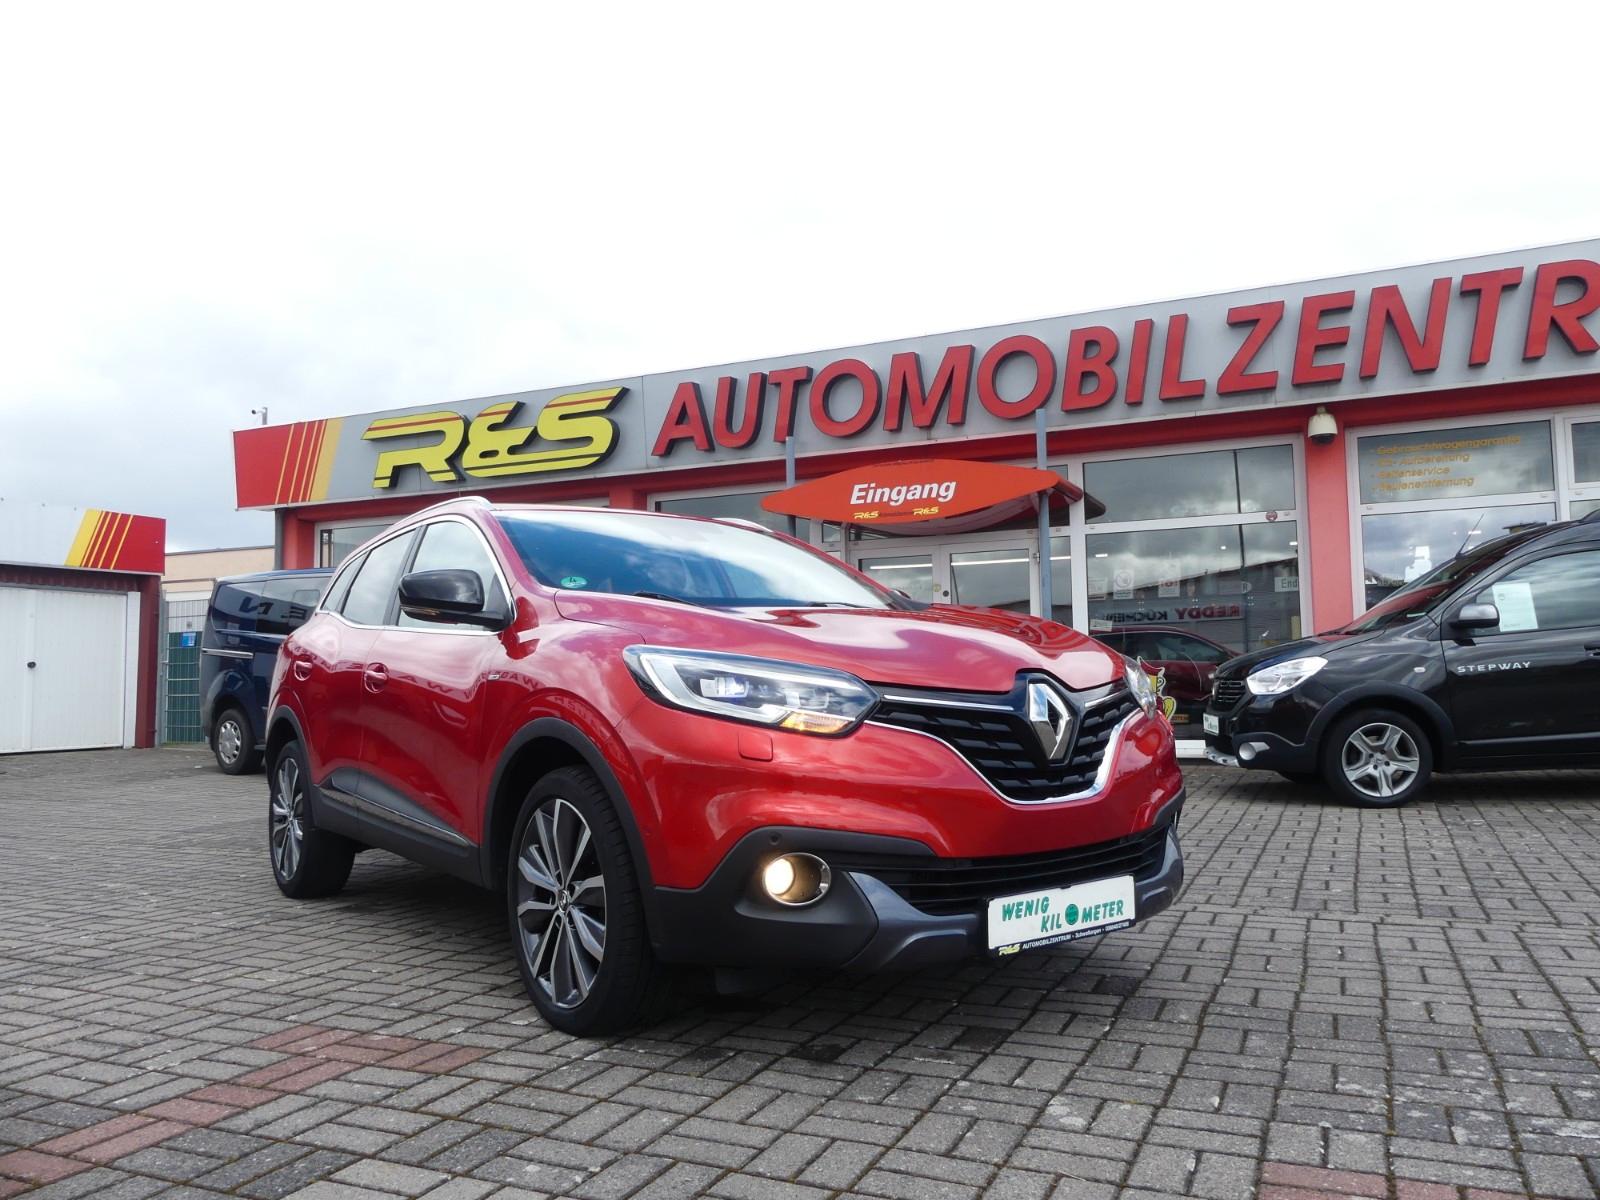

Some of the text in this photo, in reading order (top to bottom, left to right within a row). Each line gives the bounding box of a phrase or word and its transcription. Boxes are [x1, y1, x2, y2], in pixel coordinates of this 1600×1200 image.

[361, 258, 1600, 489] R&S AUTOMOBILZENTR
[850, 480, 957, 506] Eingang
[854, 506, 939, 519] R&S R&S
[1457, 661, 1531, 673] STEPWAY
[1002, 896, 1050, 921] WENIG
[1022, 934, 1072, 949] AUTOMOBILZENTRUM
